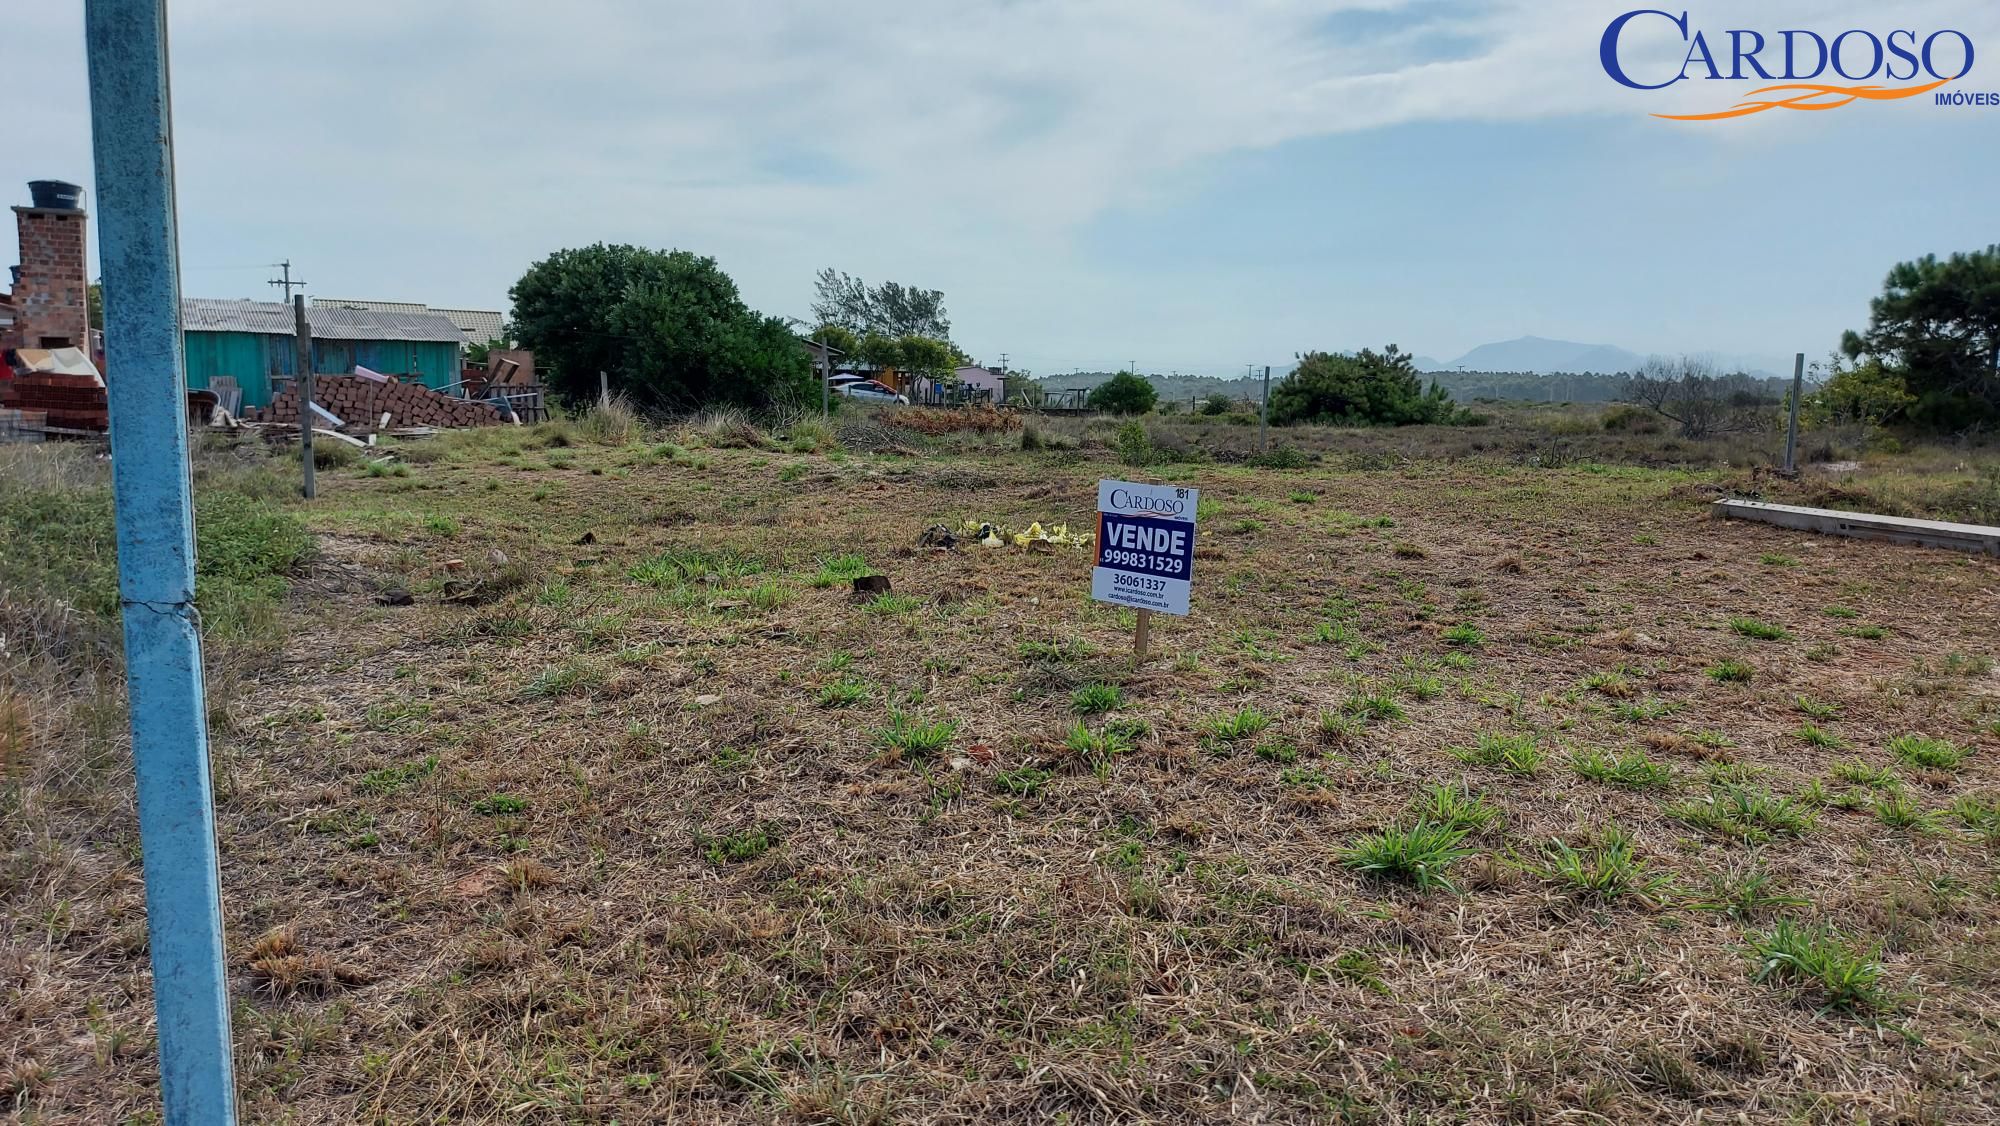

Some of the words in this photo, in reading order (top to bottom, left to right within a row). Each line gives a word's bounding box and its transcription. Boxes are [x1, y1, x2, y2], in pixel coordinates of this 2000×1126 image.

[1111, 489, 1184, 514] CARDOSO
[1176, 488, 1189, 500] 181
[1107, 522, 1186, 556] VENDE
[1105, 549, 1183, 573] 999831529
[1113, 574, 1166, 592] 36061337
